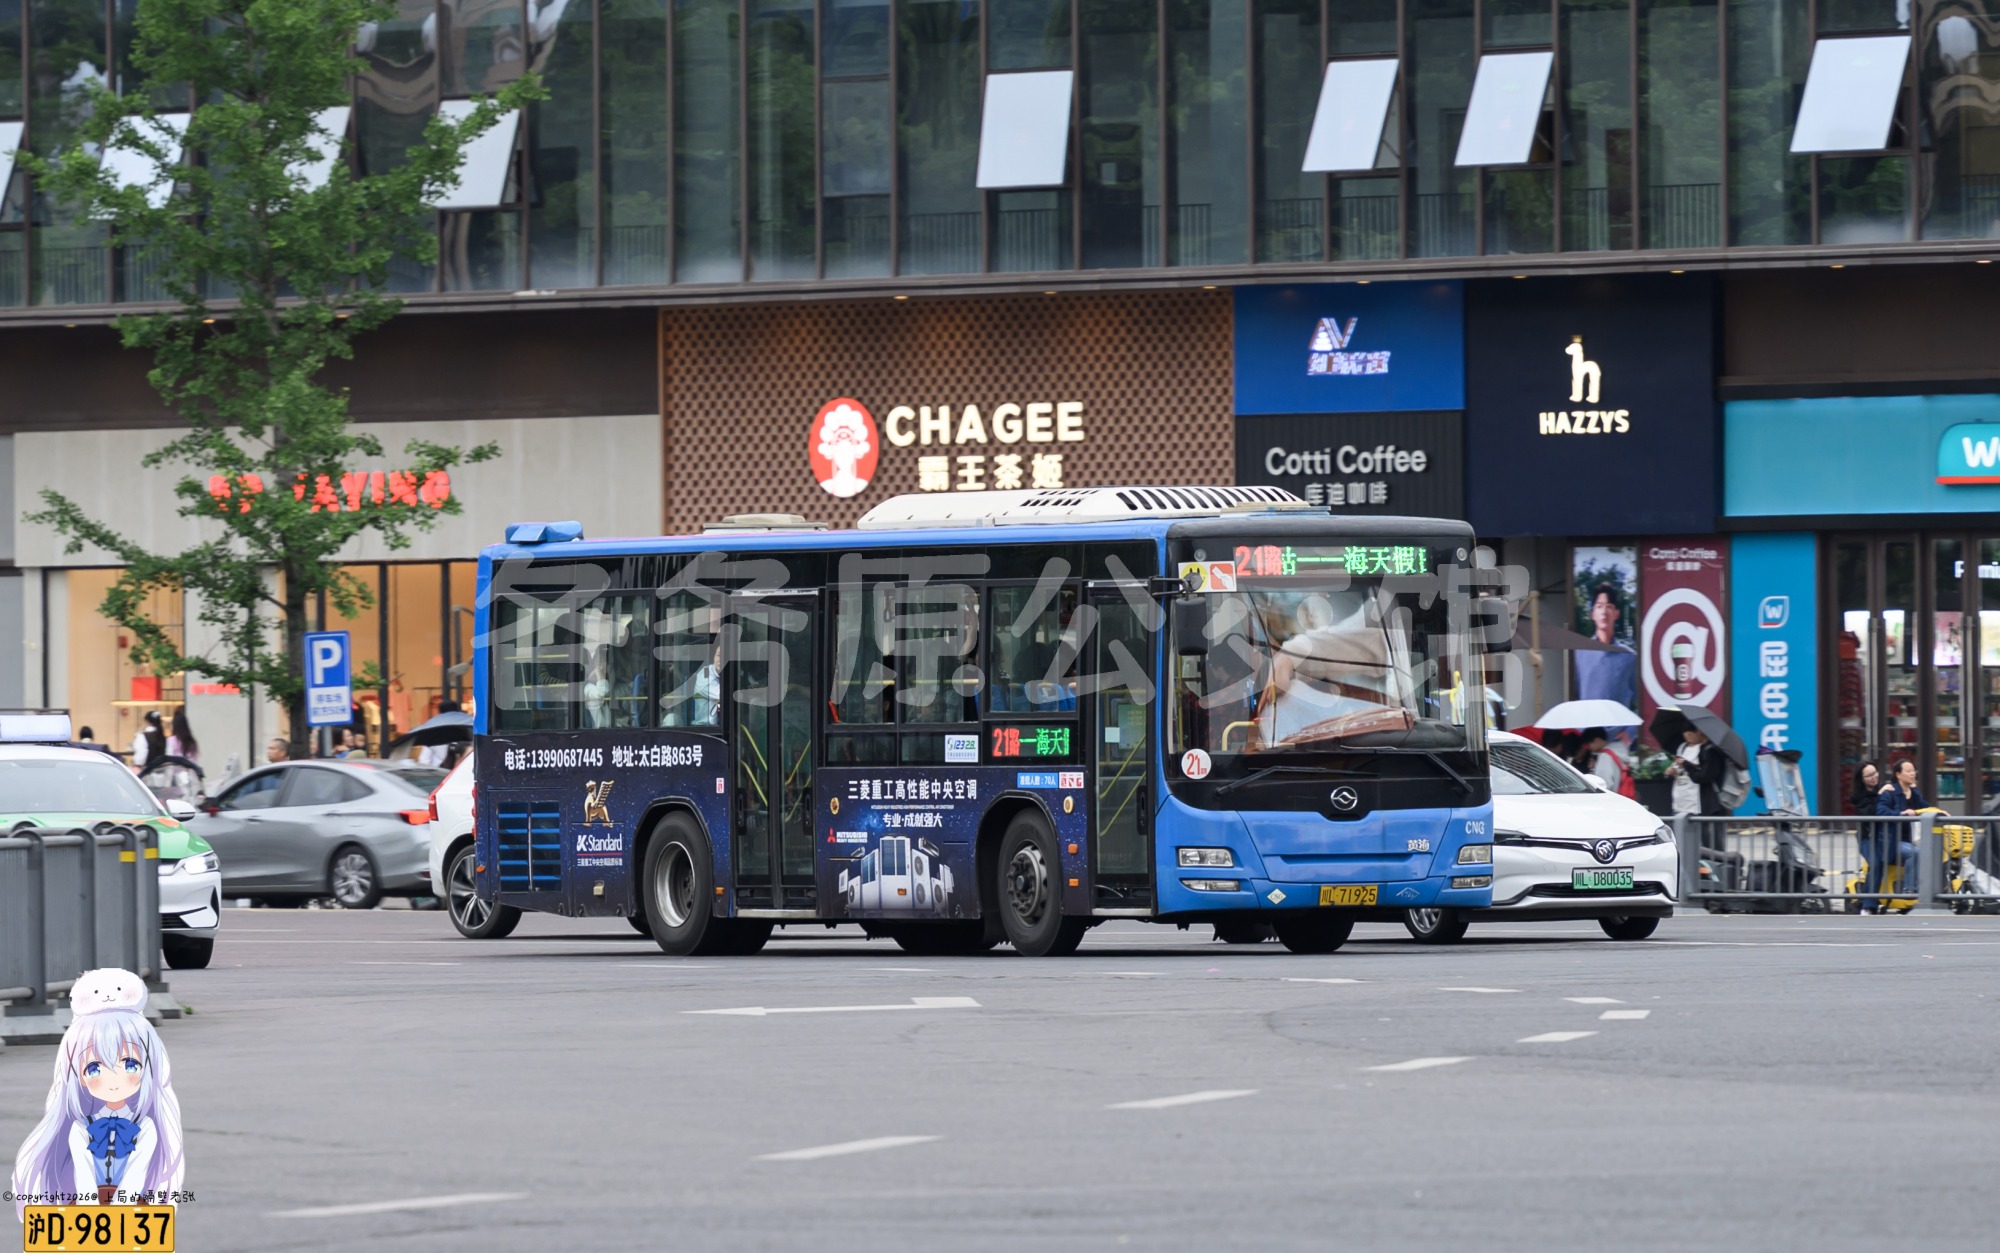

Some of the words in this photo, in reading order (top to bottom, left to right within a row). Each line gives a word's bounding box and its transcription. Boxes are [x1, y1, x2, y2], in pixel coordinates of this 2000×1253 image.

[885, 401, 1085, 447] CHAGEE
[1539, 409, 1630, 435] HAZZYS
[1265, 447, 1332, 476] Cotti
[1336, 445, 1427, 474] Coffee
[1961, 436, 2000, 468] W
[918, 453, 1064, 491] 霸王茶姬
[1305, 481, 1388, 505] 库迪咖啡
[312, 639, 343, 685] P
[992, 728, 1020, 757] 21路
[504, 748, 604, 771] 电话:13990687445
[611, 745, 703, 767] 地址:太白路863号
[848, 779, 978, 800] 三菱重工高性能中央空调
[882, 813, 943, 828] 专业·成就强大
[1465, 820, 1485, 835] CNG
